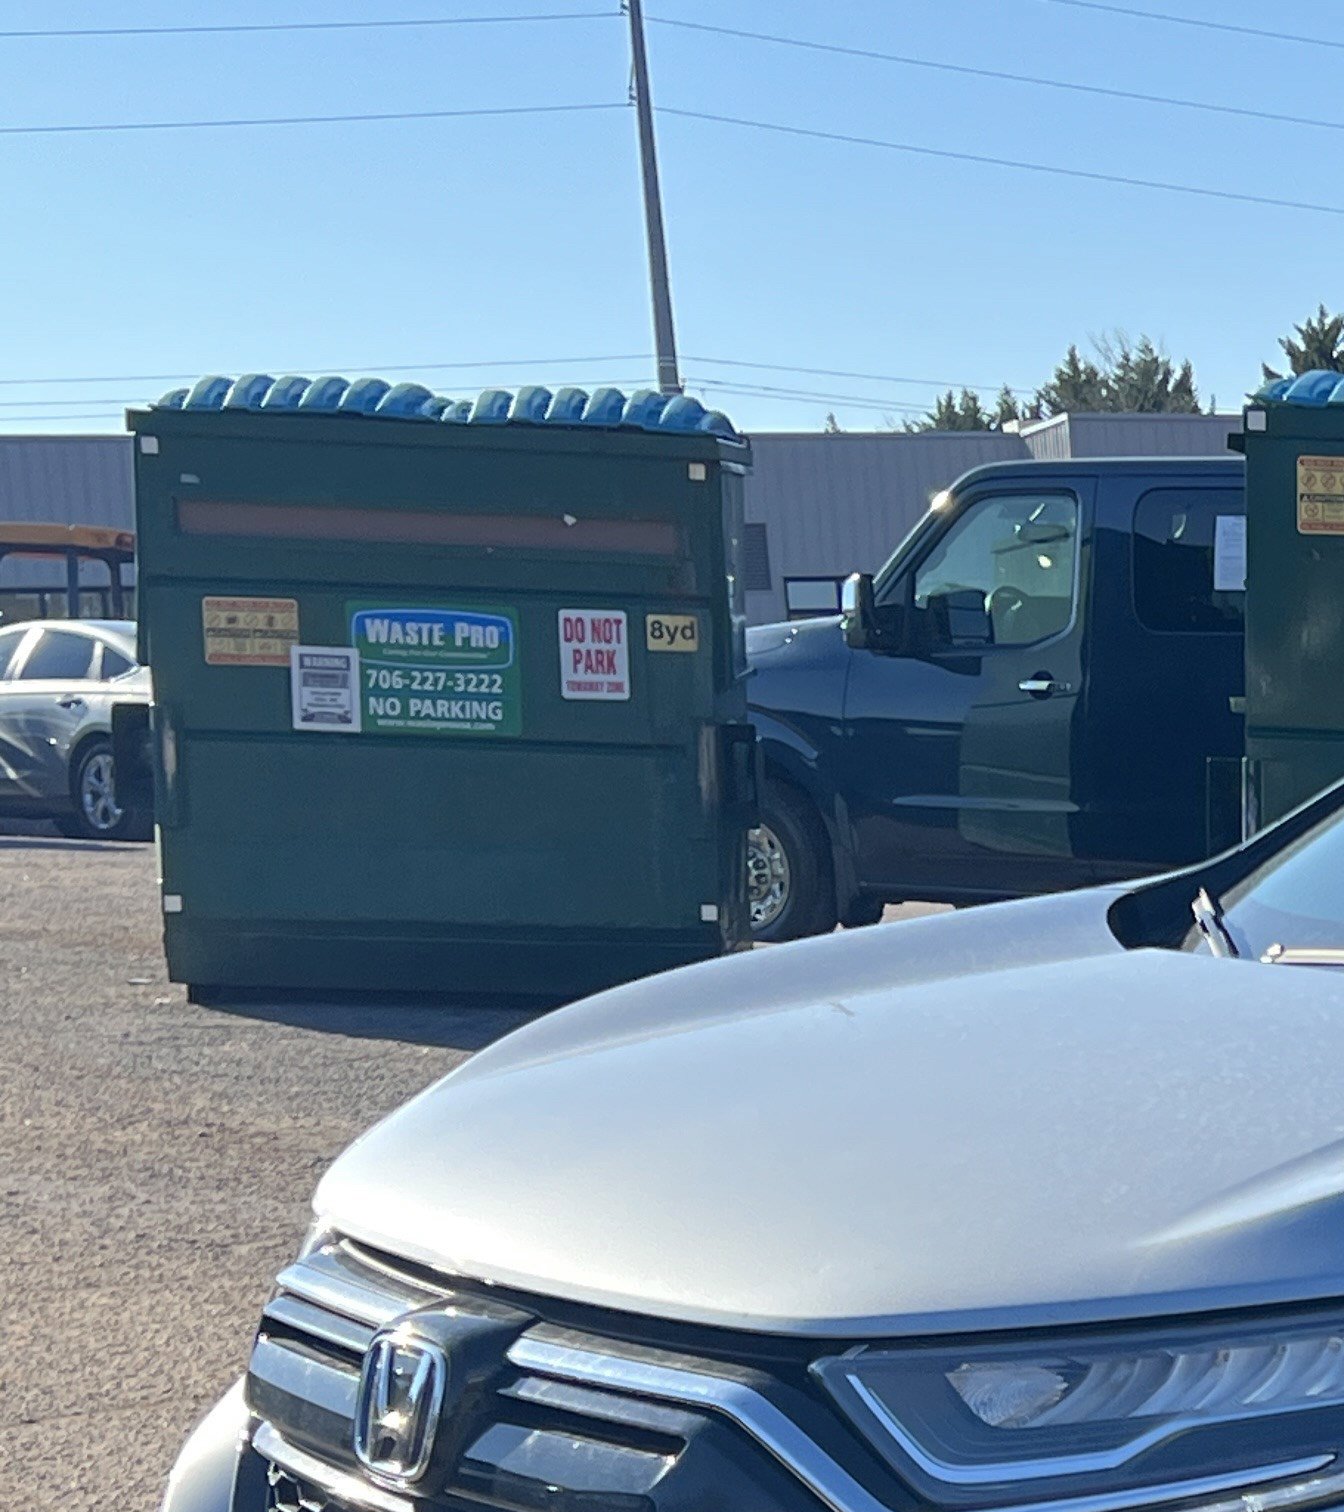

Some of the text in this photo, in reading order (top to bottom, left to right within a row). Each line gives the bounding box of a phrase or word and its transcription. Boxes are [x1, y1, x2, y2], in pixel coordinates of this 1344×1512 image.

[364, 618, 500, 649] WASTE PRO
[563, 617, 622, 644] DO NOT
[650, 619, 696, 645] 8yd
[573, 649, 617, 675] PARK
[365, 668, 503, 694] 706-227-3222
[368, 696, 504, 721] NO PARKING
